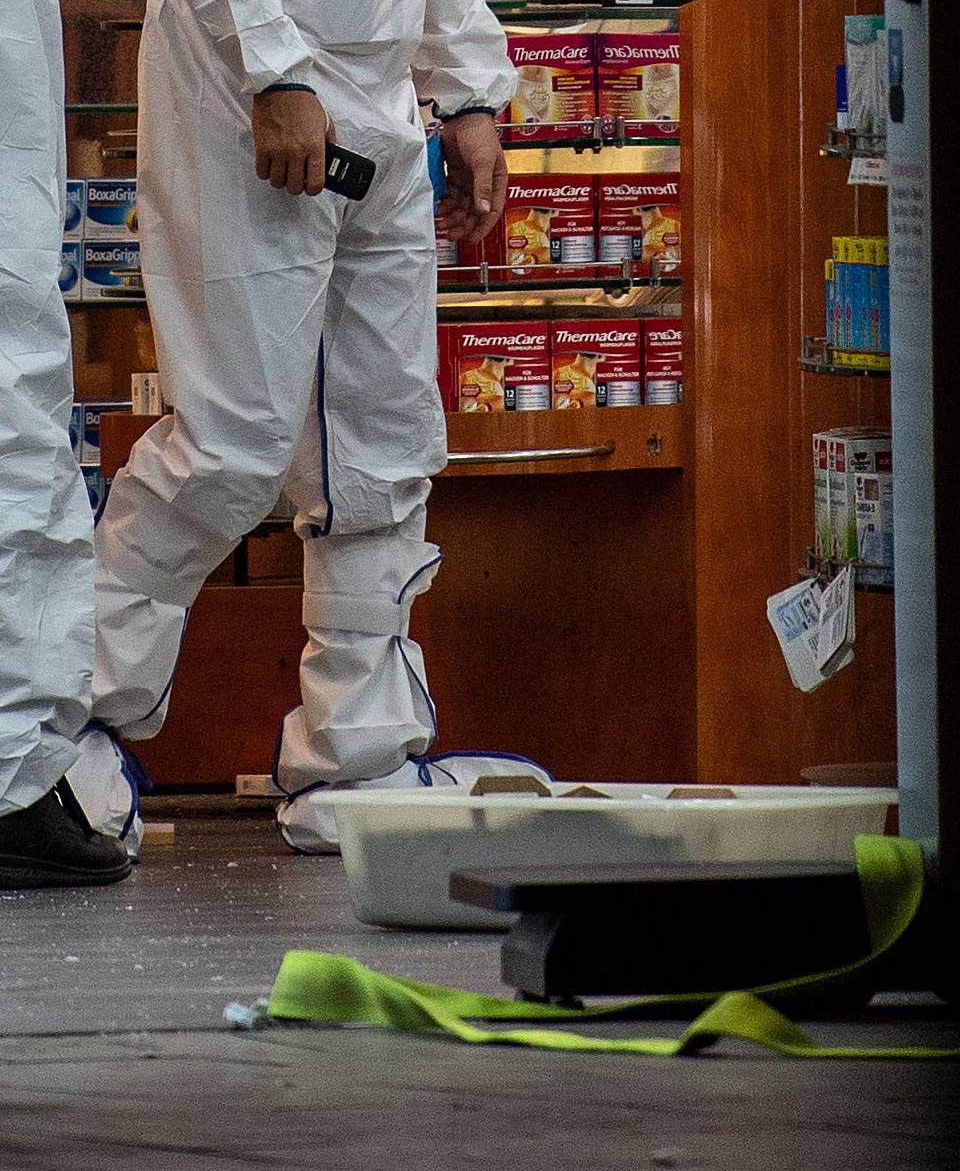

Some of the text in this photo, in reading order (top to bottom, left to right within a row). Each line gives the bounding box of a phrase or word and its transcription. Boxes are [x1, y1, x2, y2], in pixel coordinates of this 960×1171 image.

[514, 45, 588, 62] ThermaCare
[508, 185, 590, 199] ThermaCare
[552, 240, 560, 249] 12
[462, 334, 545, 348] ThermaCare
[555, 330, 637, 344] ThermaCare
[506, 390, 515, 399] 12
[597, 385, 606, 395] 12
